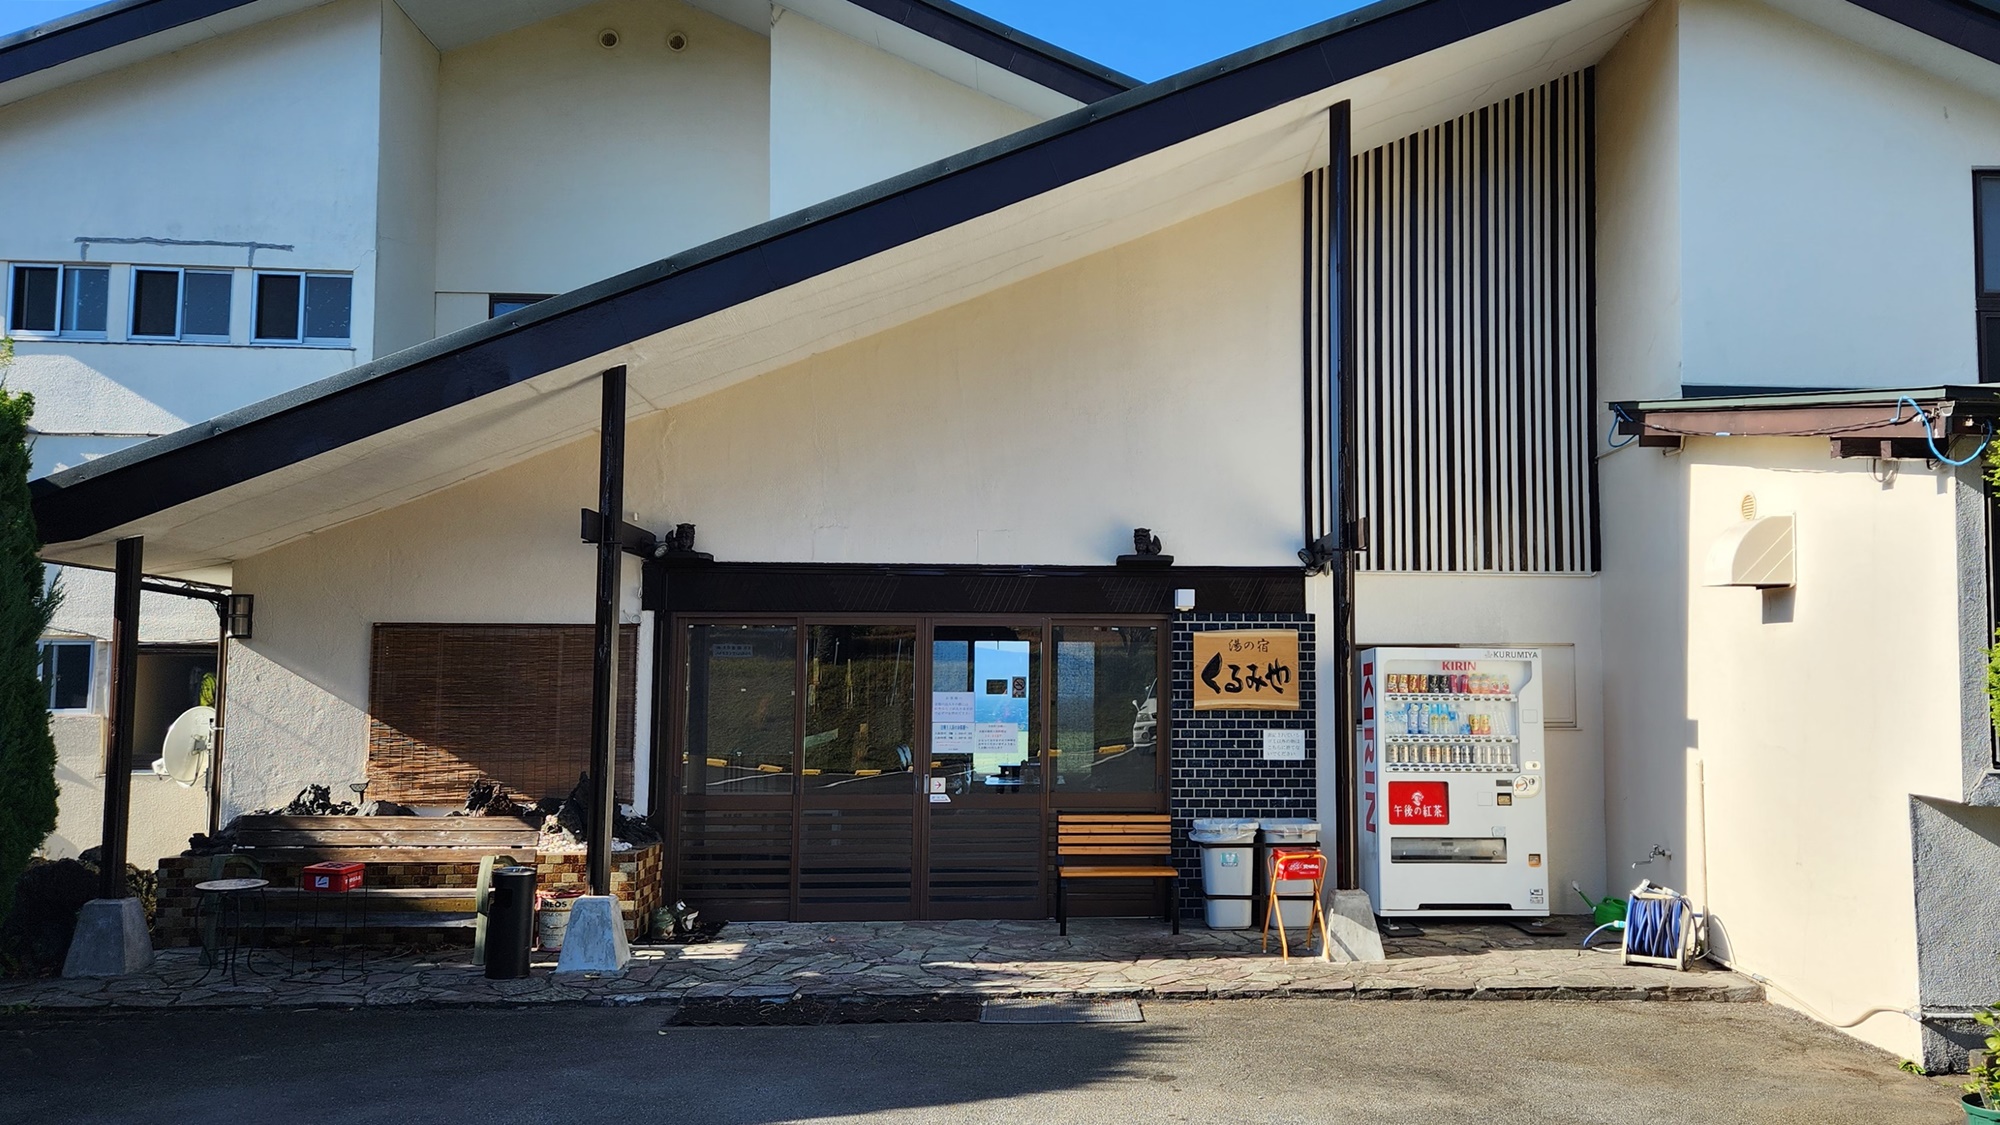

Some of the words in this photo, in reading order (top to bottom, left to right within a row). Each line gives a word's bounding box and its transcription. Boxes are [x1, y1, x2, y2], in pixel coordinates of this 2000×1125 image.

[1228, 638, 1270, 653] 湯の宿
[1201, 652, 1292, 694] くるみや
[1442, 661, 1476, 671] KIRIN
[1363, 662, 1376, 833] KIRIN
[1394, 805, 1443, 818] 午後の紅茶
